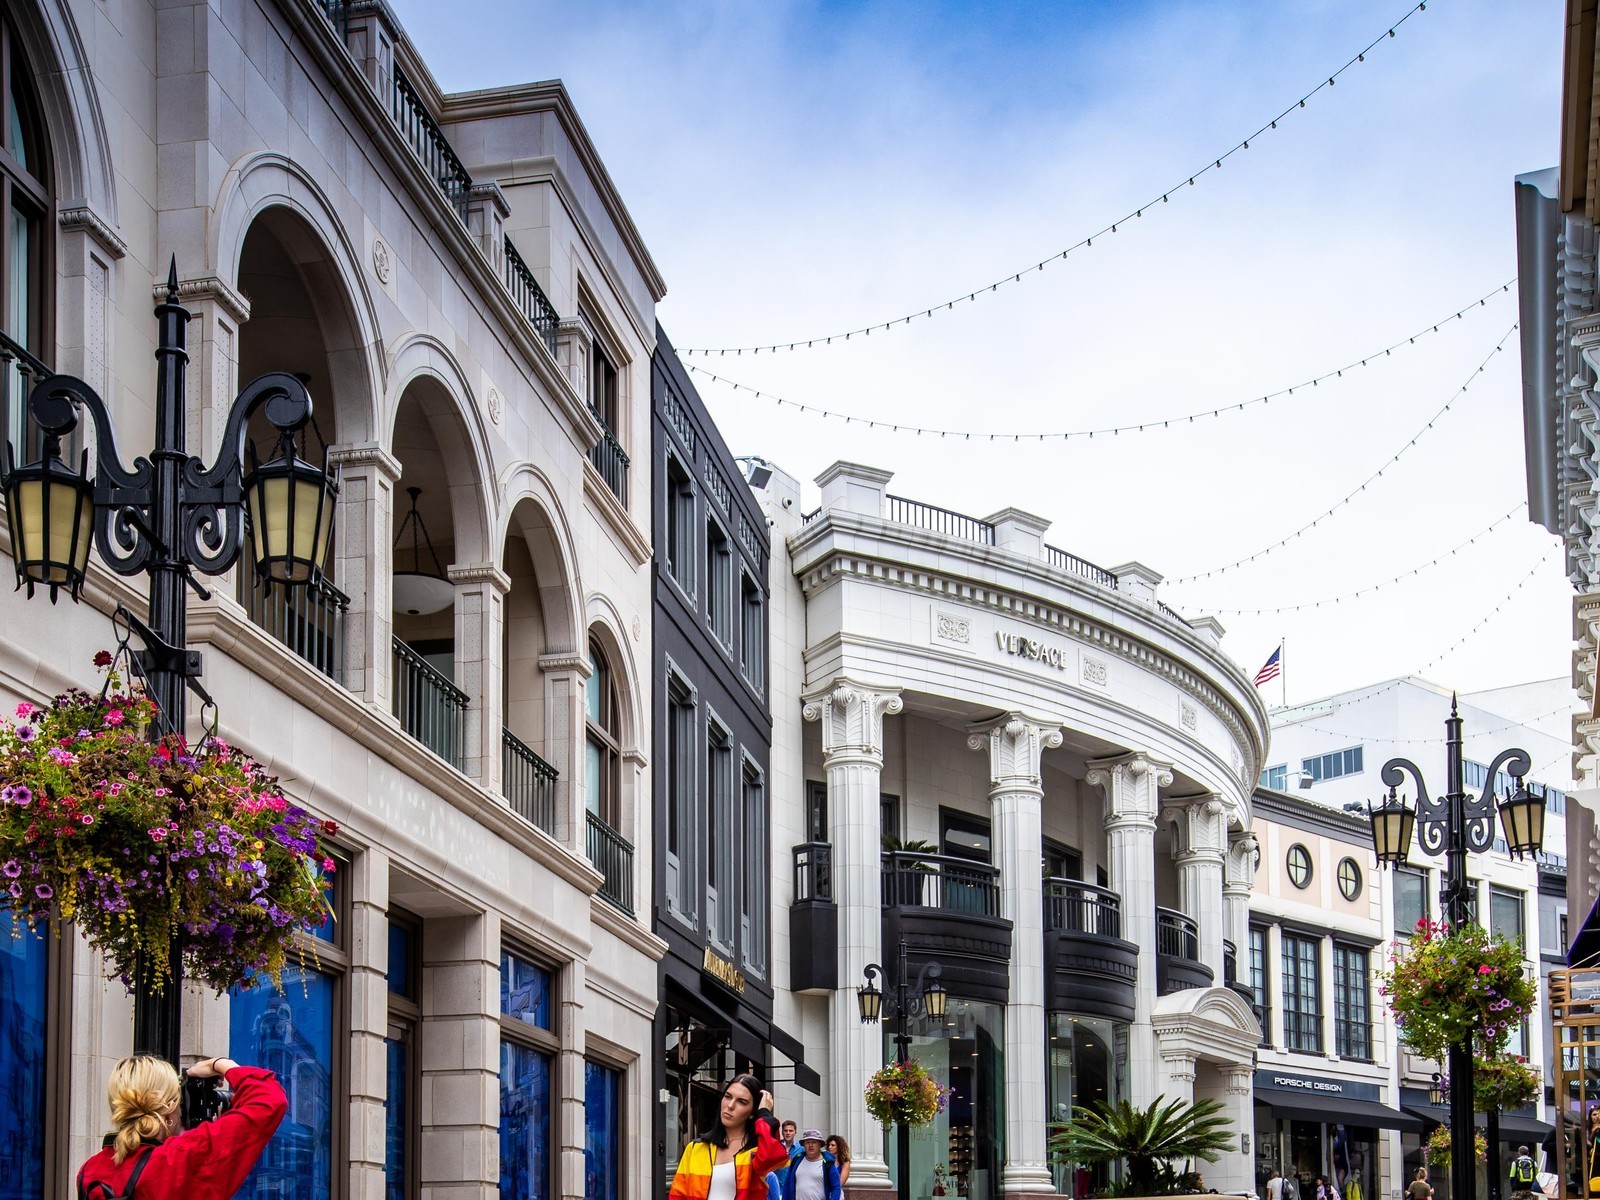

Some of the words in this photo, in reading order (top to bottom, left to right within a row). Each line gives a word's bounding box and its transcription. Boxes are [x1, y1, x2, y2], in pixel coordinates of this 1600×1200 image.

[996, 630, 1067, 670] VERSACE
[1274, 1077, 1312, 1089] PORSCHE
[1314, 1082, 1342, 1092] DESIGN
